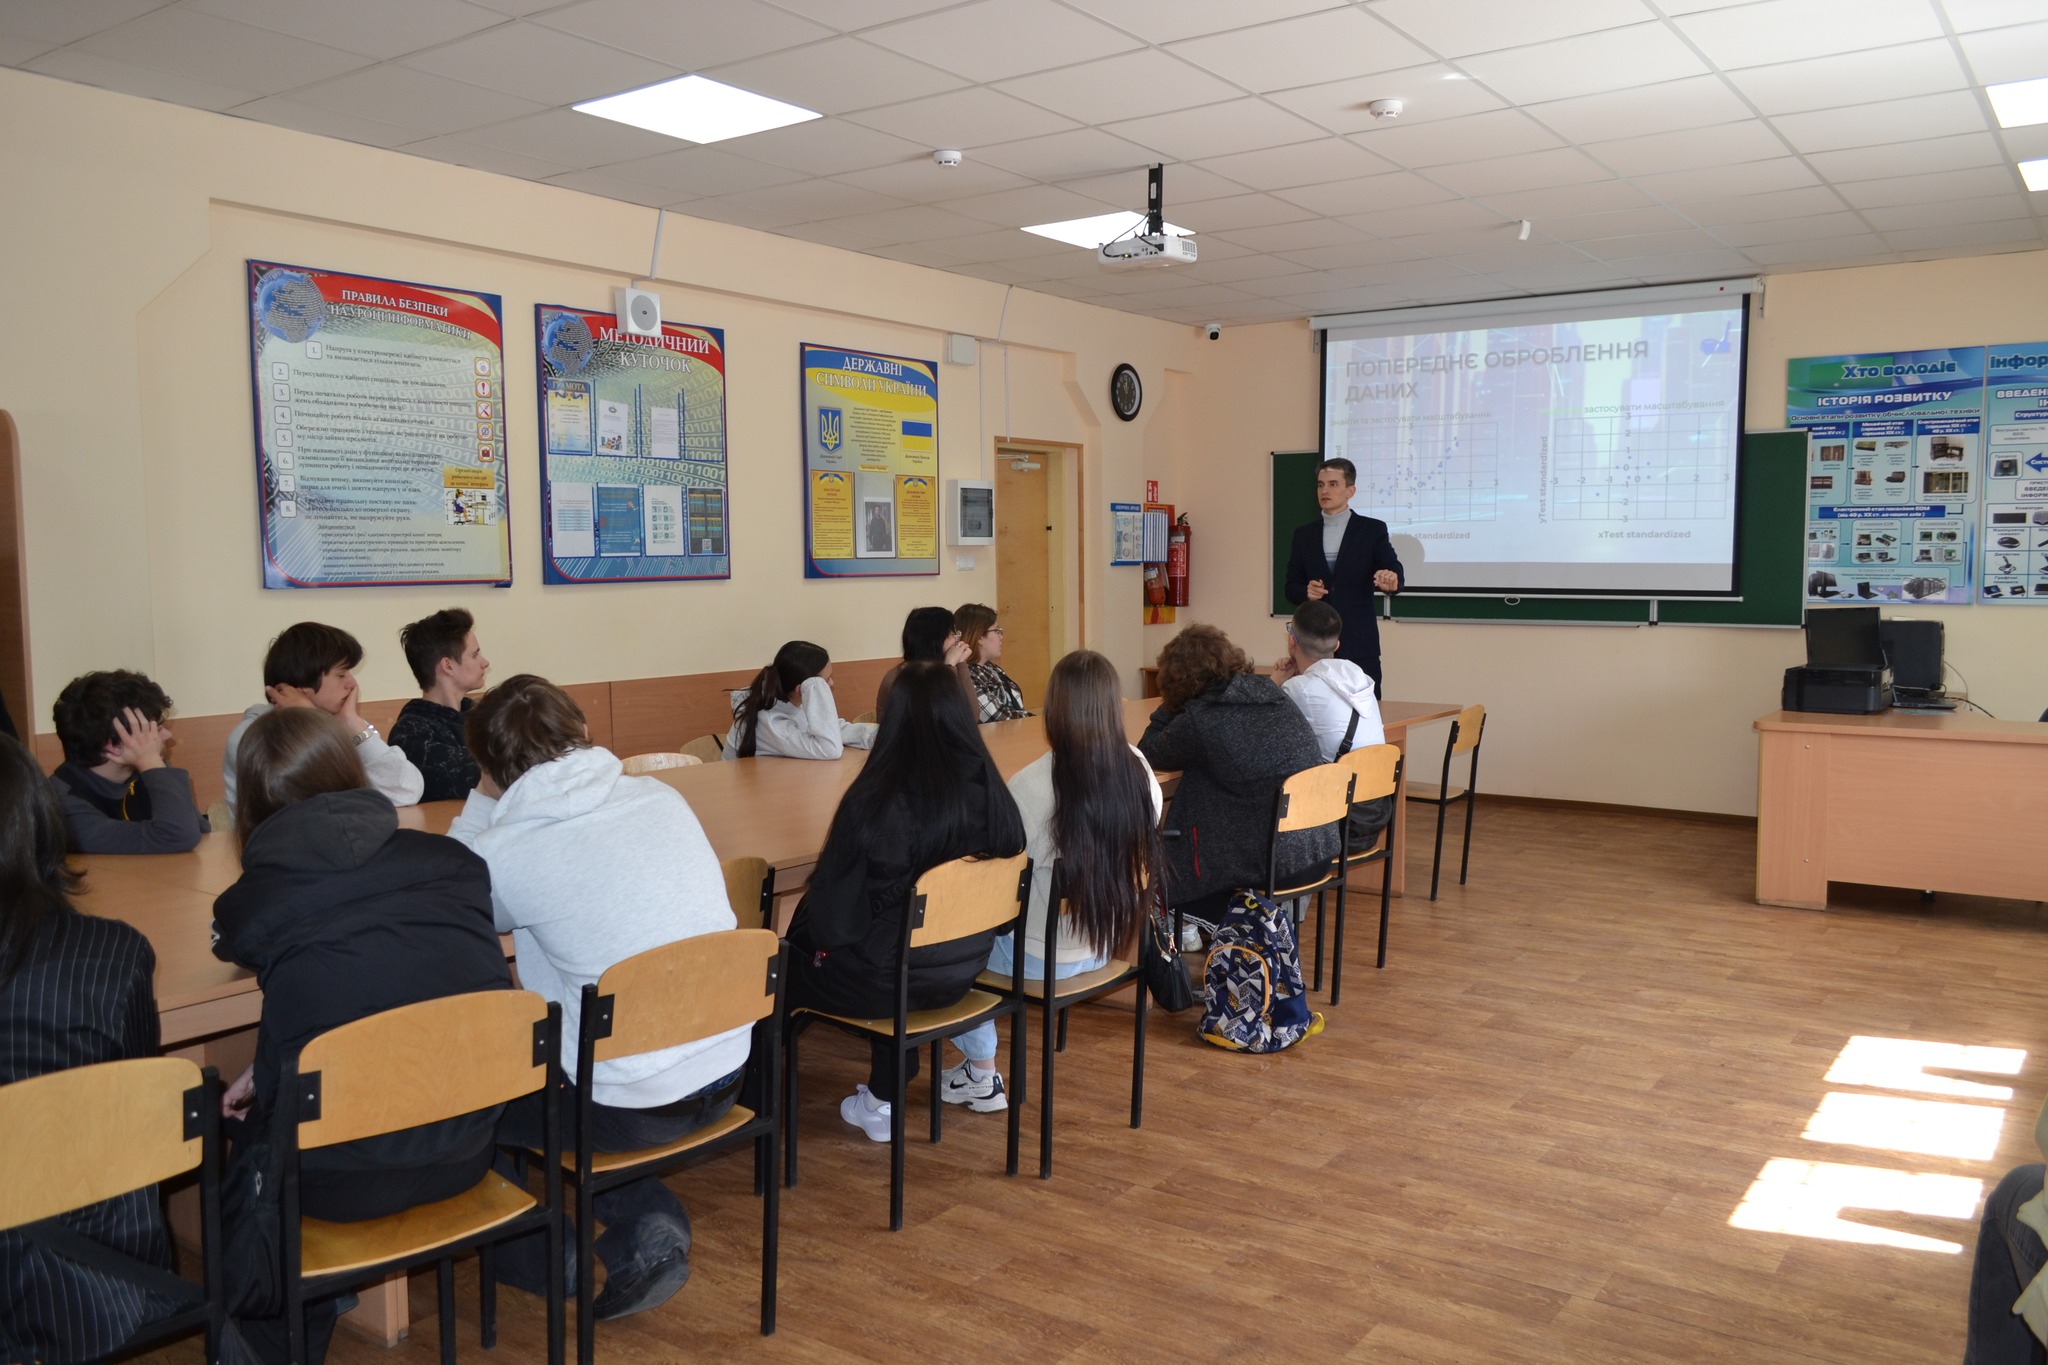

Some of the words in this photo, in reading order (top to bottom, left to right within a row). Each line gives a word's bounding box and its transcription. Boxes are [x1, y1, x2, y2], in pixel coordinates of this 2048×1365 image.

[342, 290, 397, 307] ПРАВИЛА
[399, 298, 449, 317] БЕЗПЕКИ
[329, 304, 347, 317] НА
[347, 307, 386, 323] УРОЦІ
[387, 311, 472, 341] ІНФОРМАТИКИ
[600, 327, 710, 354] МЕТОДИЧНИЙ
[620, 352, 691, 373] КУТОЧОК
[1346, 352, 1479, 378] ПОПЕРЕДНЄ
[1485, 340, 1649, 369] ОБРОБЛЕННЯ
[1990, 354, 2048, 370] інфор
[842, 356, 903, 377] ДЕРЖАВНІ
[1842, 364, 1880, 379] Хто
[1882, 359, 1957, 376] володіє
[551, 380, 586, 391] ГРАМОТА
[816, 372, 877, 392] СИМВОЛИ
[879, 380, 927, 398] УКРАЇНИ
[1345, 381, 1420, 405] ДАНИХ
[1817, 394, 1872, 407] ІСТОРІЯ
[1874, 391, 1952, 405] РОЗВИТКУ
[1996, 389, 2048, 399] ВВЕДЕН
[1583, 404, 1642, 415] застосувати
[1644, 400, 1725, 411] масштабування
[1844, 411, 1881, 420] розвитку
[1882, 408, 1948, 418] обчислювальної
[1950, 407, 1980, 415] техніки
[1370, 415, 1421, 425] застосувати
[1423, 411, 1492, 424] масштабування
[1625, 429, 1631, 437] 2
[1408, 439, 1414, 447] 2
[282, 456, 289, 464] 6.
[1539, 435, 1549, 493] standardized
[1577, 476, 1586, 484] -2
[1605, 475, 1613, 483] -1
[1633, 475, 1640, 483] 0
[1693, 474, 1700, 482] 2
[1722, 473, 1729, 482] 3
[1368, 482, 1376, 490] -2
[1538, 494, 1549, 525] yTest
[1598, 530, 1625, 540] xTest
[1626, 529, 1691, 540] standardized
